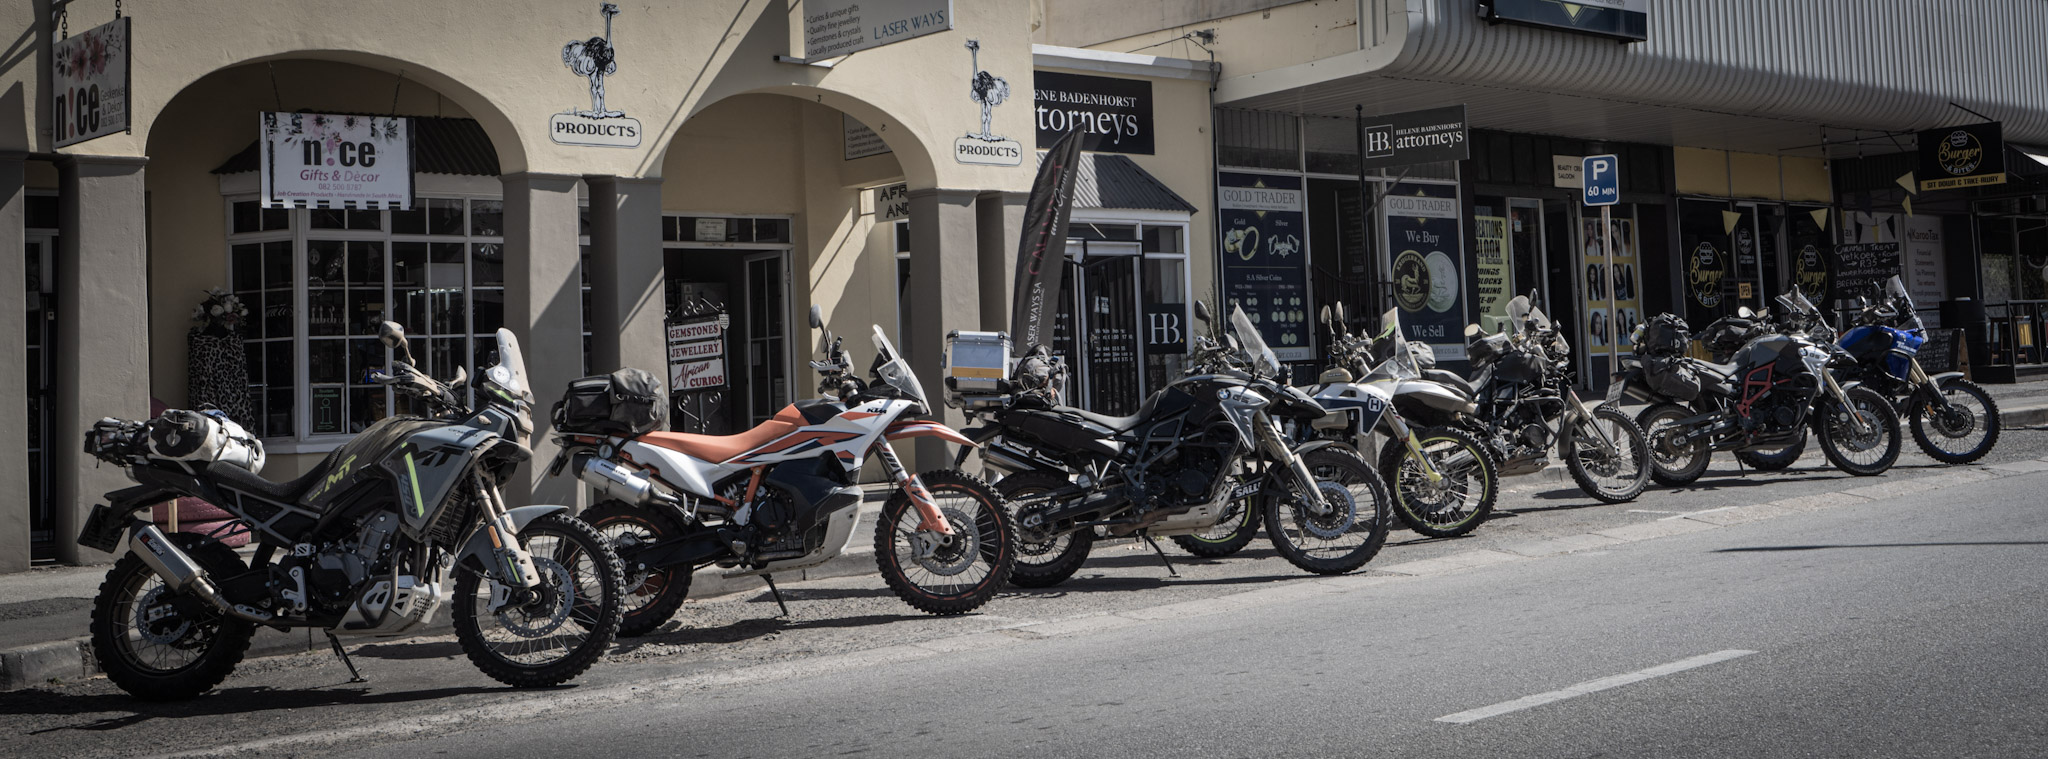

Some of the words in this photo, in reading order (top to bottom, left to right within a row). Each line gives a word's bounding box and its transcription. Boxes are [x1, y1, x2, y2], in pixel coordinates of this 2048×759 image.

[809, 13, 825, 24] Curios
[825, 12, 829, 20] &
[830, 7, 847, 19] unique
[848, 4, 859, 16] gifts
[810, 22, 827, 35] Quality
[827, 20, 837, 30] fine
[837, 15, 860, 28] jewellery
[874, 19, 908, 40] LASER
[911, 10, 945, 30] WAYS
[811, 33, 837, 46] Gemstones
[838, 31, 842, 39] &
[842, 26, 861, 37] crystals
[811, 45, 827, 57] Locally
[828, 39, 851, 53] produced
[852, 36, 864, 47] craft
[1060, 91, 1136, 107] BADENHORST
[556, 122, 636, 137] PRODUCTS
[1035, 105, 1138, 144] torneys
[1396, 127, 1420, 136] HELENE
[1421, 122, 1462, 133] BADENHORST
[1396, 130, 1463, 148] attorneys
[959, 144, 1018, 158] PRODUCTS
[1940, 141, 1980, 166] Burger
[300, 169, 329, 181] Gifts
[332, 170, 341, 181] &
[1593, 160, 1609, 180] P
[1953, 163, 1975, 174] BITES
[1224, 189, 1252, 202] GOLD
[1254, 191, 1296, 204] TRADER
[1587, 185, 1599, 196] 60
[1602, 187, 1615, 196] MIN
[1390, 198, 1414, 209] GOLD
[1416, 199, 1452, 212] TRADER
[1234, 218, 1246, 226] Gold
[1406, 230, 1421, 243] We
[1422, 230, 1440, 246] Buy
[1912, 229, 1939, 240] KarooTax
[1690, 255, 1724, 295] Burger
[1796, 258, 1826, 295] Burger
[1032, 281, 1042, 294] SA
[1029, 295, 1040, 322] WAYS
[670, 324, 718, 339] GEMSTONES
[1412, 325, 1427, 337] We
[1428, 324, 1445, 337] Sell
[671, 343, 719, 358] JEWELLERY
[673, 361, 710, 388] African
[690, 375, 723, 387] CURIOS
[324, 453, 357, 493] MT
